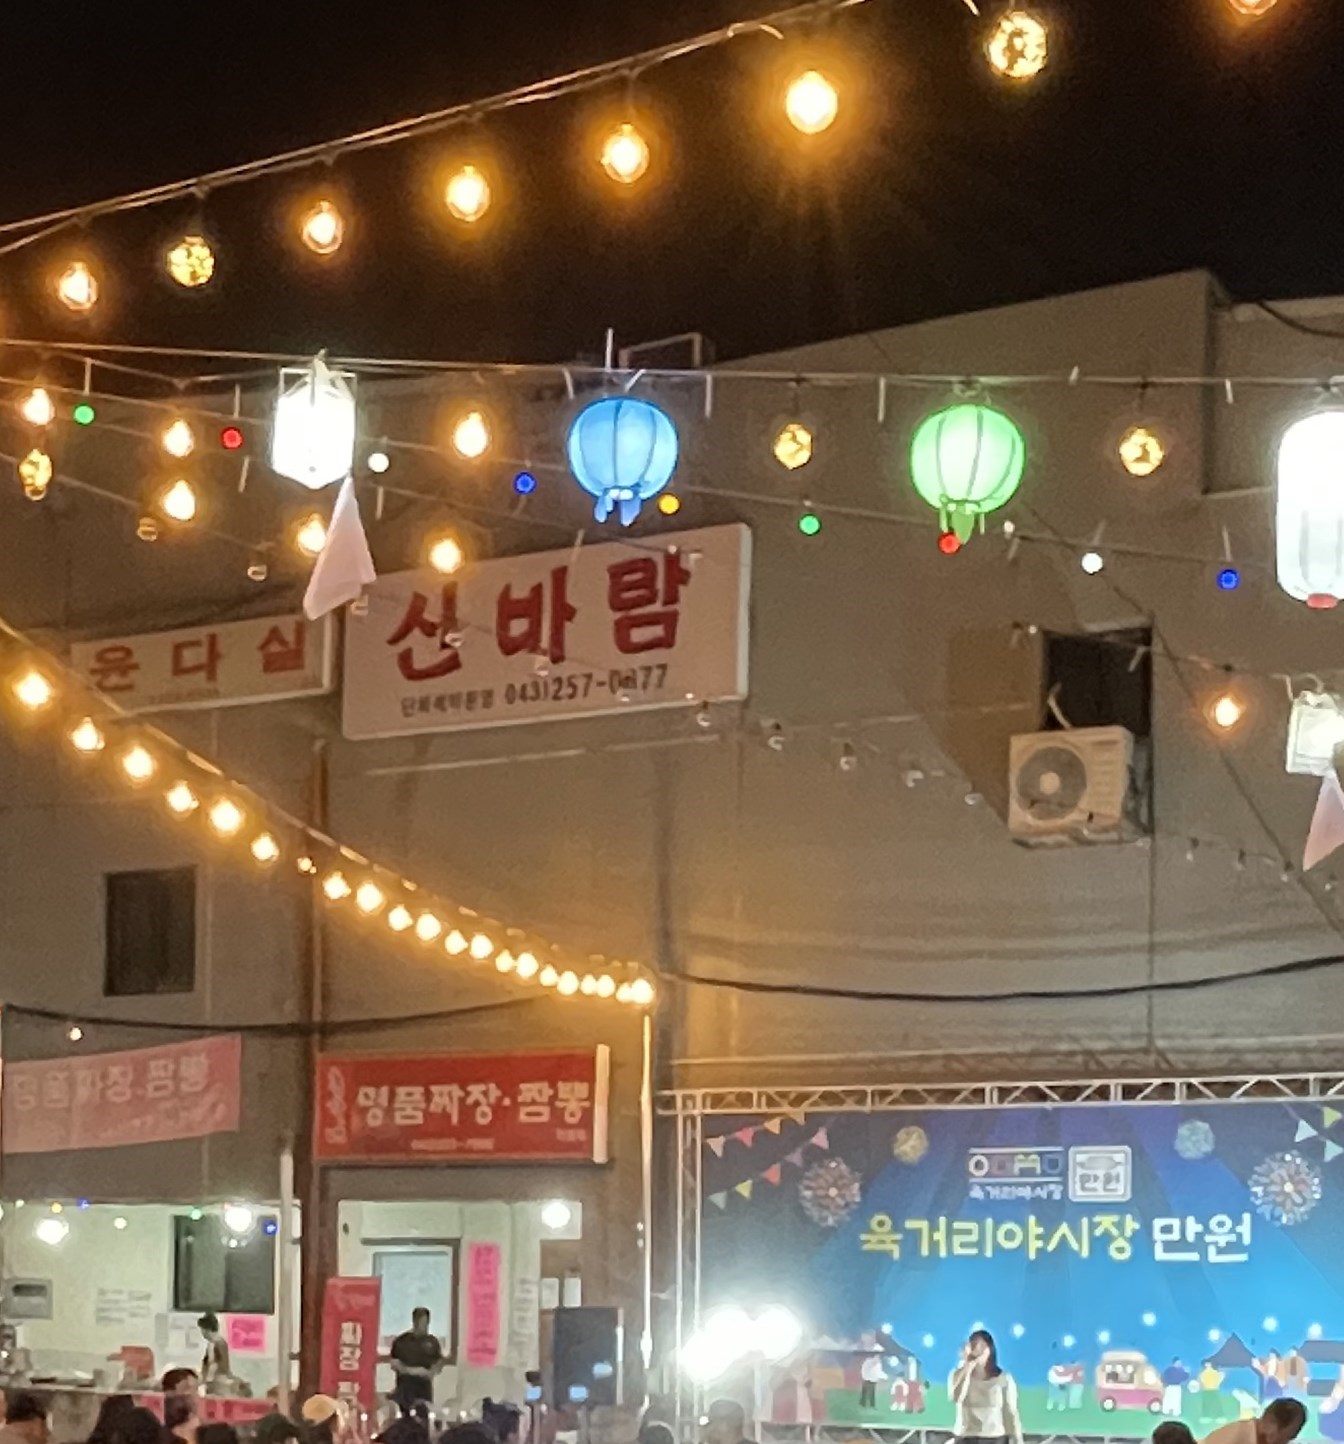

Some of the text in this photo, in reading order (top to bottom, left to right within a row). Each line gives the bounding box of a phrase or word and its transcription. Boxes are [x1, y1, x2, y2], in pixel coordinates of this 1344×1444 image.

[386, 551, 692, 682] 신바람
[859, 1212, 1252, 1263] 육거리야시장 만원
